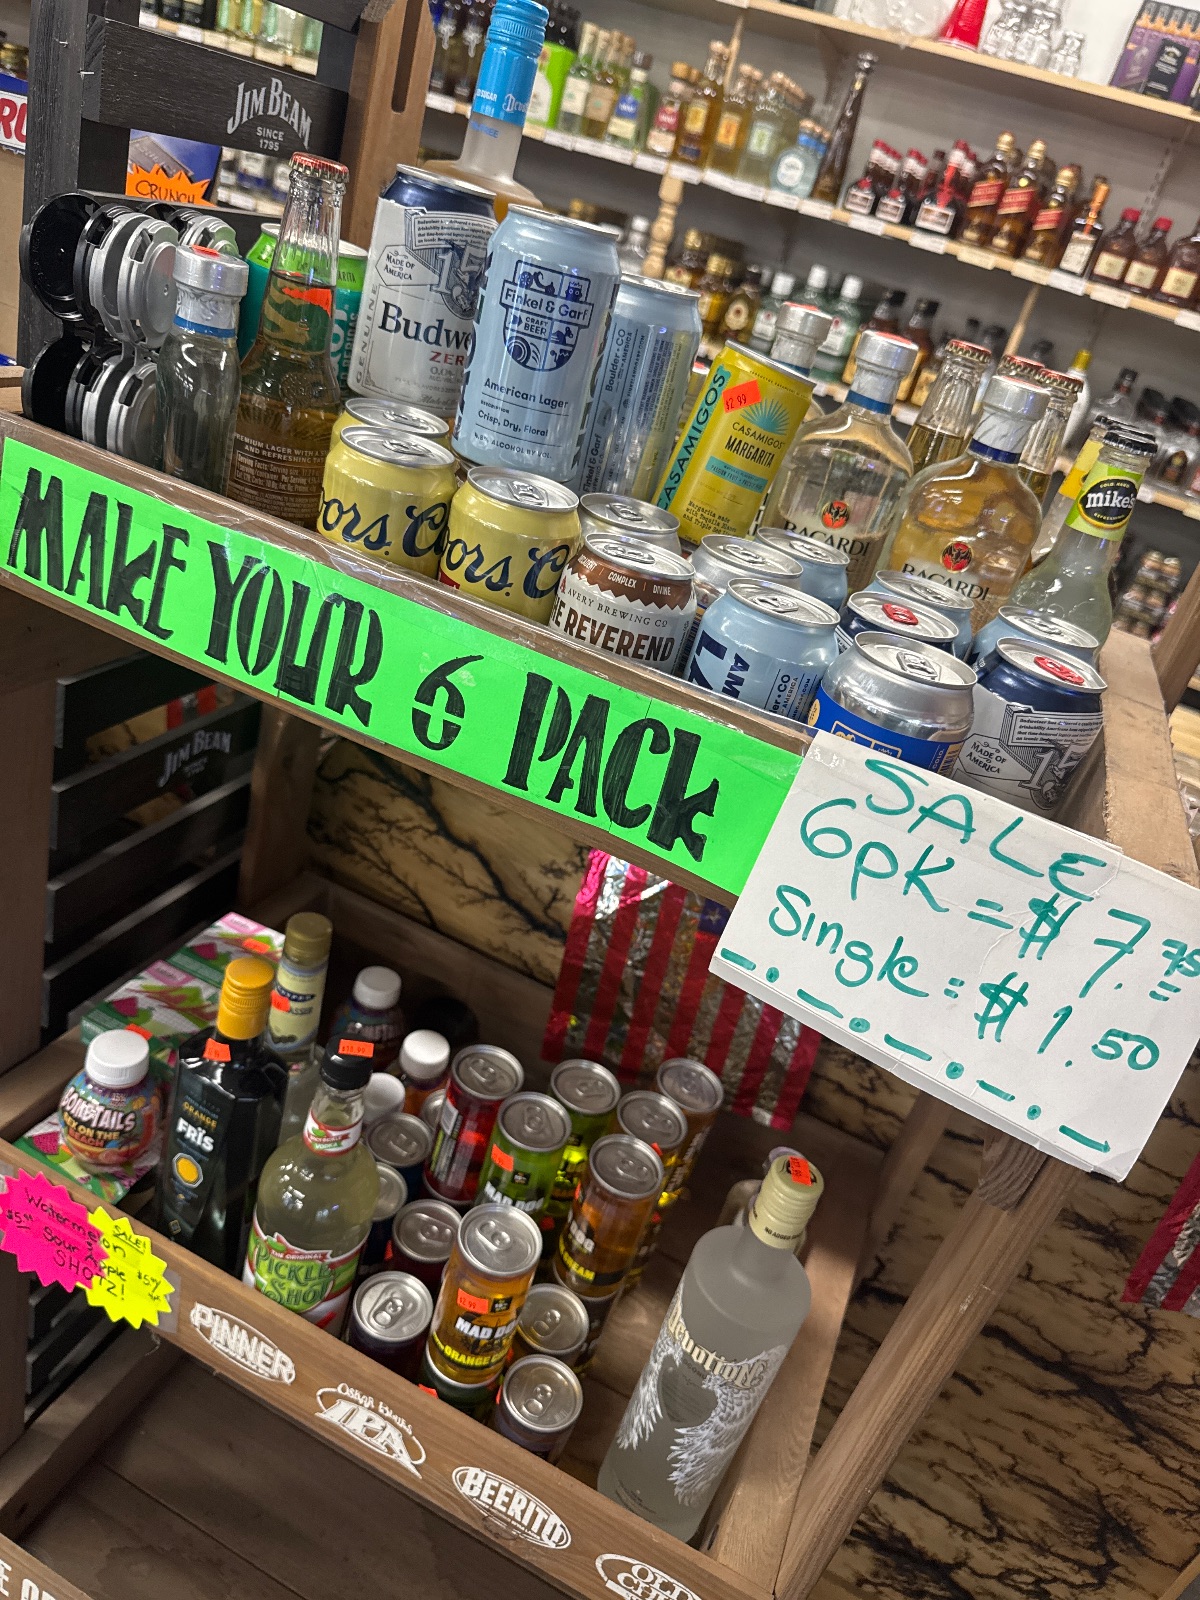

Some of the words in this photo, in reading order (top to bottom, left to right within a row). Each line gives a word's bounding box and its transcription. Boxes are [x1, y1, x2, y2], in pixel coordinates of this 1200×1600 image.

[227, 81, 268, 134] JIM
[268, 77, 312, 150] BEAM
[256, 126, 284, 141] SINCE
[259, 139, 280, 151] 1795
[384, 265, 413, 280] AMERICA
[386, 253, 405, 266] MADE
[406, 261, 415, 270] OF
[504, 290, 544, 312] Finkel
[546, 300, 555, 312] &
[558, 304, 588, 322] Garf
[524, 323, 547, 336] BEER
[525, 316, 548, 327] CRAFT
[356, 284, 378, 383] GENUINE
[430, 351, 465, 366] ZER
[605, 354, 620, 392] Boulder
[616, 329, 625, 345] CO
[484, 378, 535, 402] American
[539, 394, 568, 409] Lager
[478, 409, 500, 427] Crisp,
[503, 419, 521, 432] Dry,
[524, 425, 548, 437] Floral
[492, 440, 524, 453] ALCOHOL
[591, 435, 602, 456] Garf
[657, 372, 726, 510] CASAMIGOS
[732, 421, 784, 450] CASAMIGOS
[245, 445, 260, 454] AND
[262, 450, 311, 463] REFRESHING
[266, 444, 292, 454] LAGER
[589, 455, 596, 465] &
[725, 435, 775, 468] MARGARITA
[583, 466, 594, 493] Finkel
[688, 500, 716, 518] Margarita
[1086, 489, 1134, 509] mike's
[686, 507, 698, 517] with
[694, 519, 712, 530] Triple
[608, 571, 637, 589] COMPLEX
[653, 585, 671, 596] DIVINE
[568, 588, 594, 607] AVERY
[597, 602, 651, 625] BREWING
[551, 597, 566, 628] HE
[563, 607, 675, 662] REVEREND
[7, 466, 190, 641] MAKE
[204, 539, 383, 728] YOUR
[411, 654, 485, 751] 6
[501, 671, 720, 862] PACK
[966, 751, 1000, 774] AMERICA
[971, 742, 993, 759] MADE
[995, 754, 1008, 764] OF
[865, 758, 1107, 902] SALE
[768, 883, 930, 999] Single
[183, 1101, 217, 1128] ORANGE
[77, 1125, 95, 1137] ON
[96, 1130, 120, 1140] THE
[256, 1243, 331, 1286] PICKLE
[455, 1317, 493, 1340] MAD
[193, 1301, 295, 1385] PINNER
[444, 1344, 491, 1365] ORANGE
[462, 1468, 566, 1548] BEERITO
